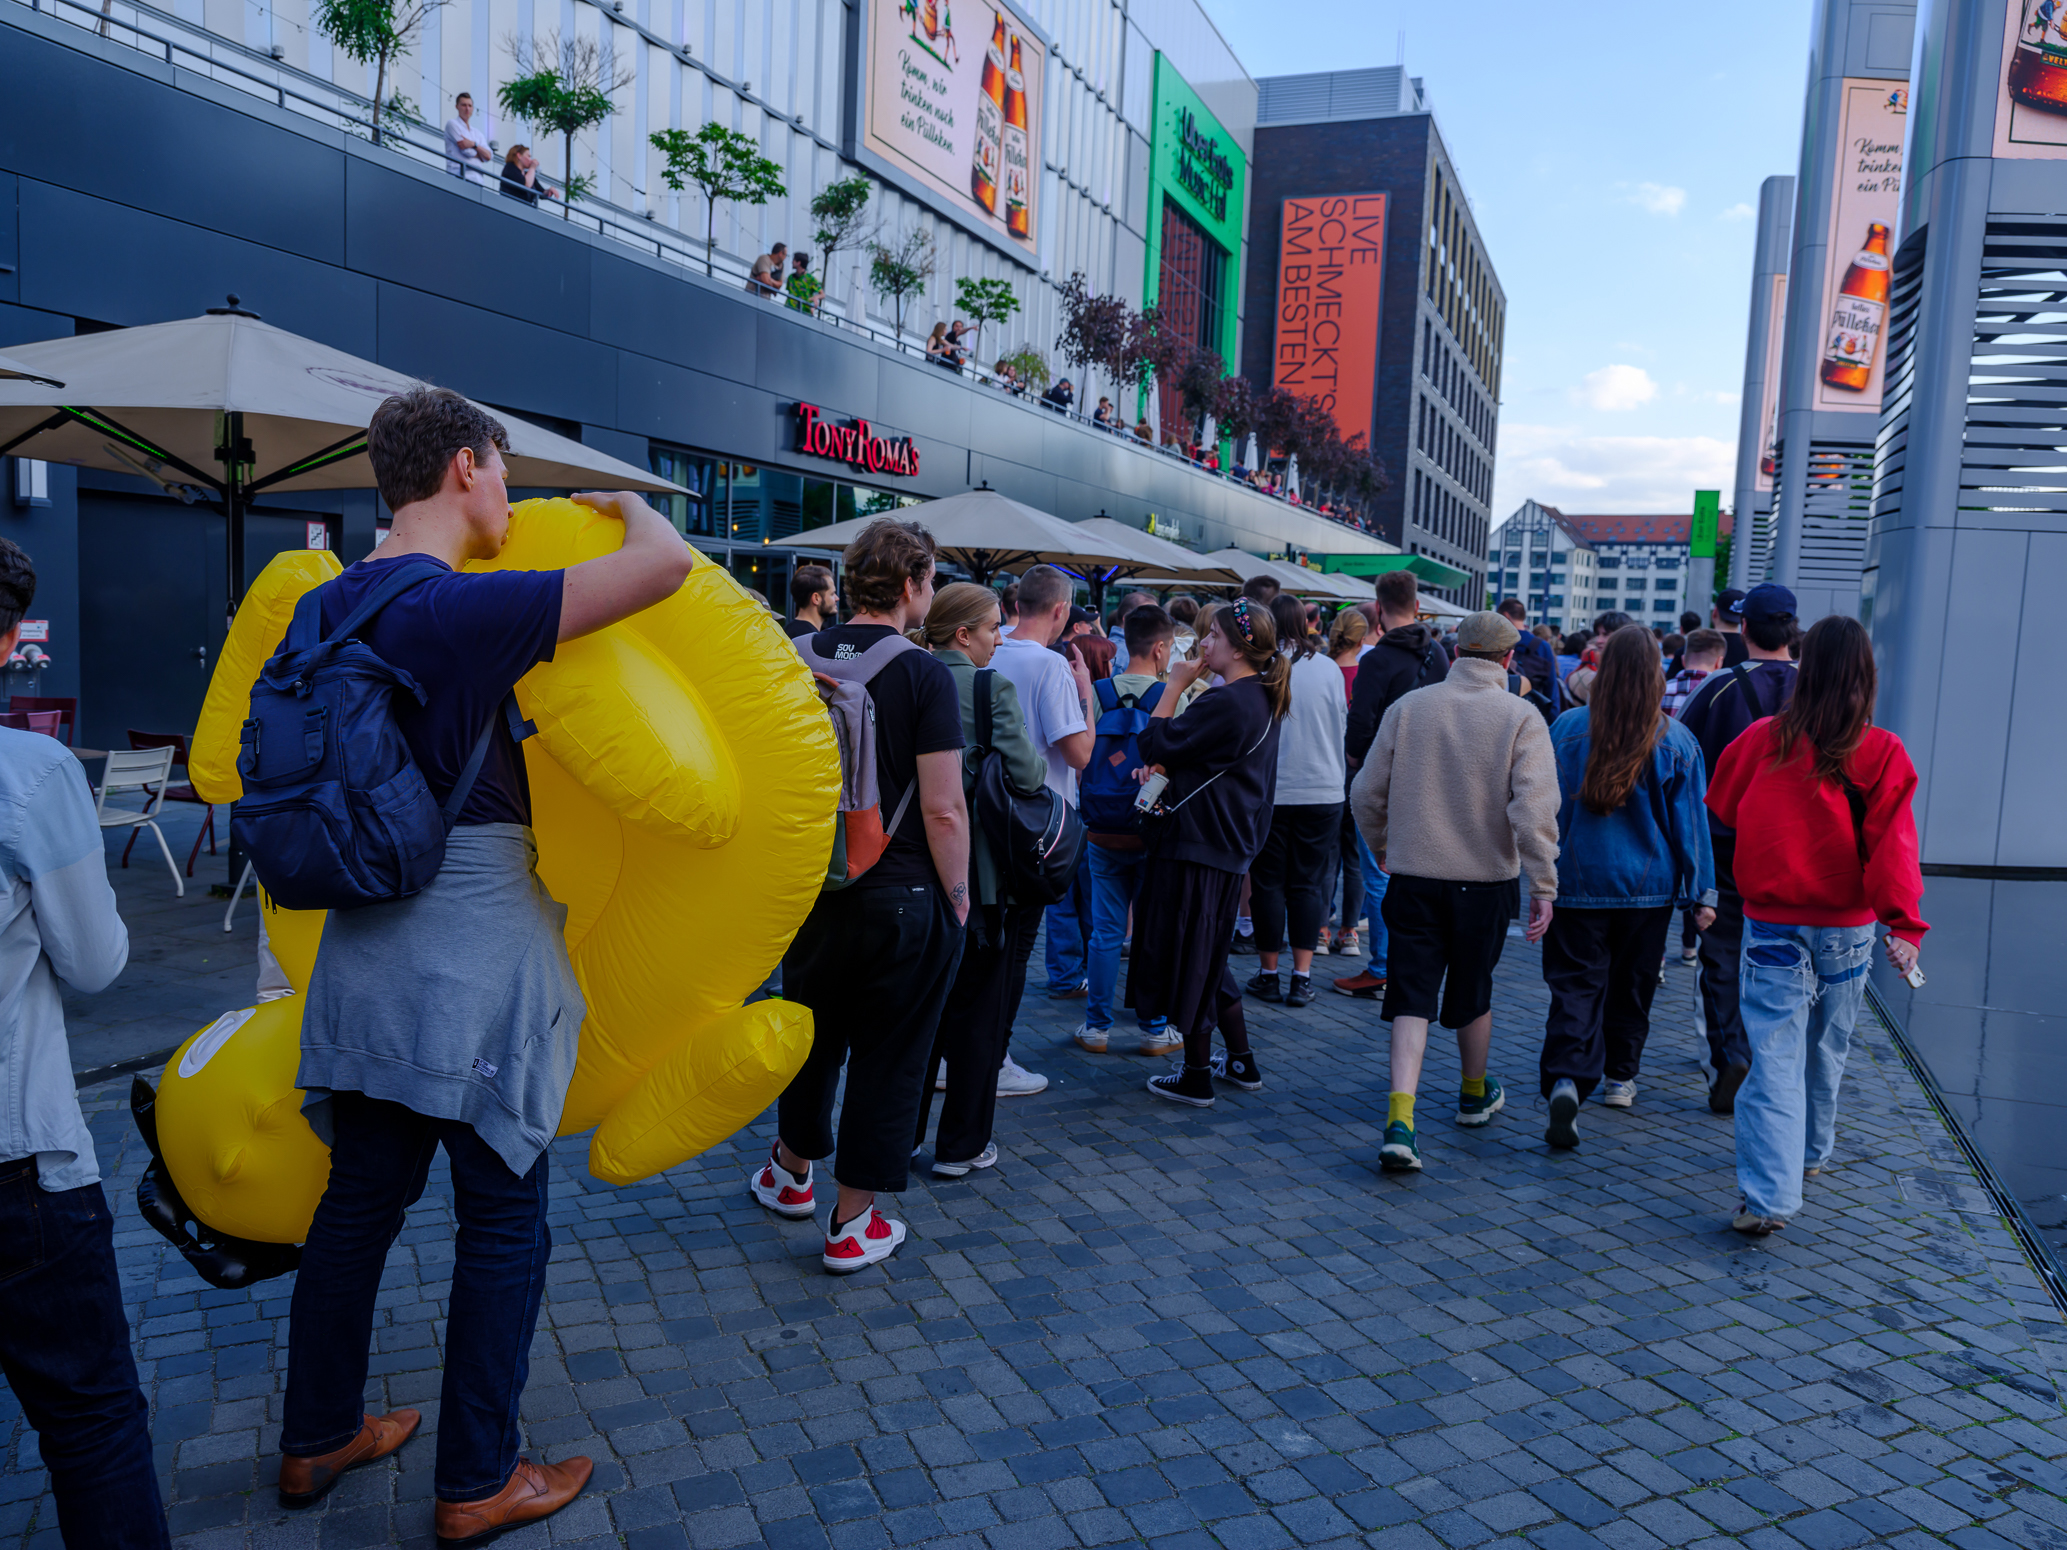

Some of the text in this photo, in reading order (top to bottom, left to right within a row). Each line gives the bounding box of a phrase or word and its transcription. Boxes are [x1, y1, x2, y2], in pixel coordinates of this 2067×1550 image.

[901, 79, 933, 115] trinken
[901, 111, 914, 131] ein
[1857, 179, 1878, 192] ein
[1350, 198, 1380, 265] LIVE
[1279, 201, 1314, 384] AM BESTEN
